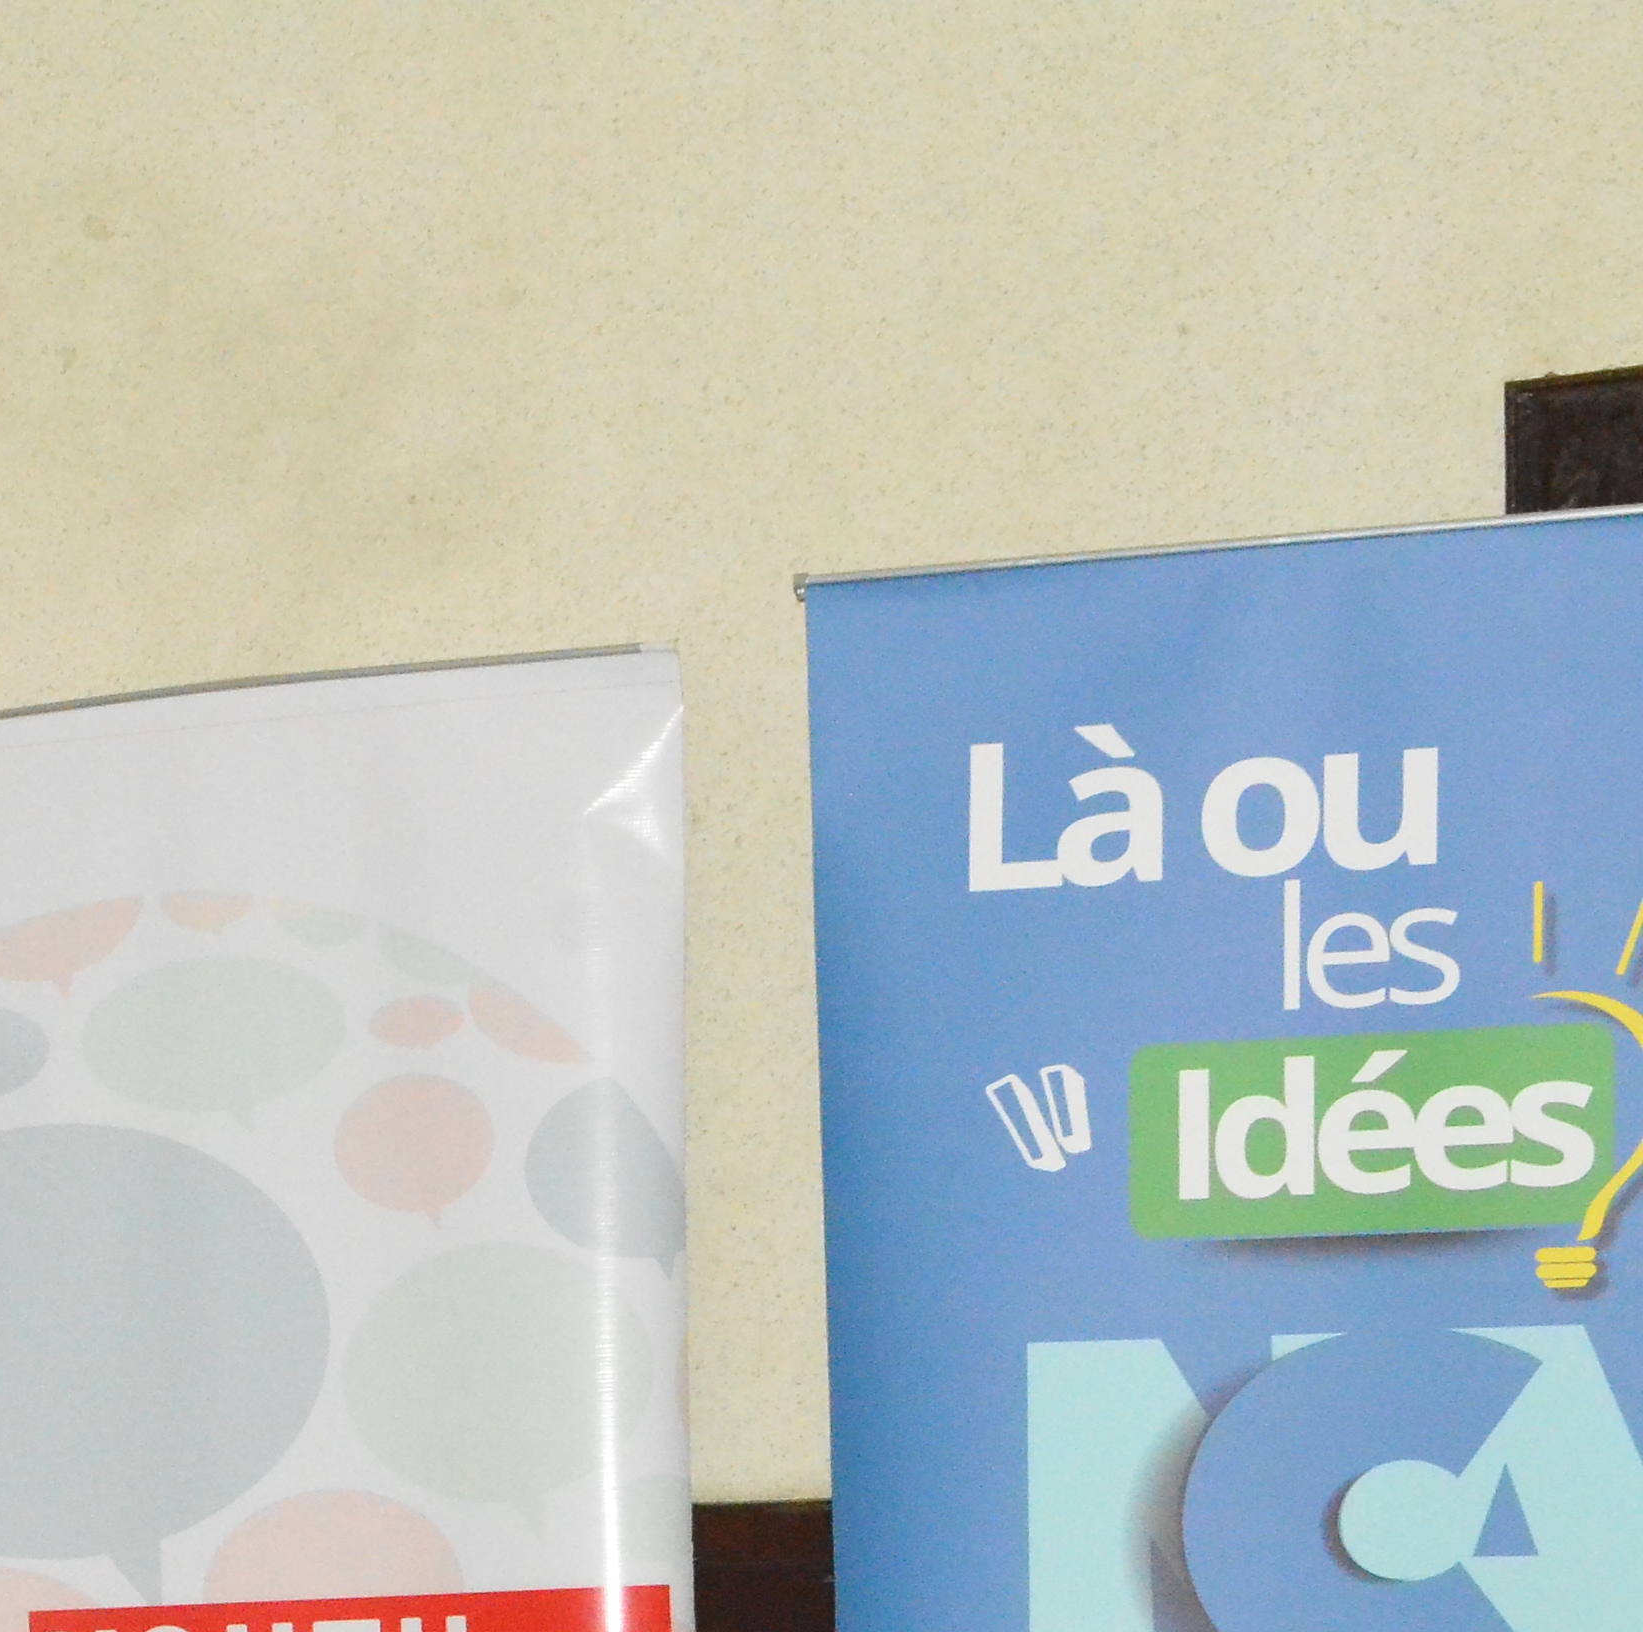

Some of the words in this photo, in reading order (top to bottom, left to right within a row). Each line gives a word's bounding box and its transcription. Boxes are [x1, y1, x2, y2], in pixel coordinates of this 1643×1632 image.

[969, 723, 1164, 893] Là
[1201, 746, 1439, 878] ou
[1283, 878, 1461, 1012] les
[1178, 1049, 1596, 1201] Idées
